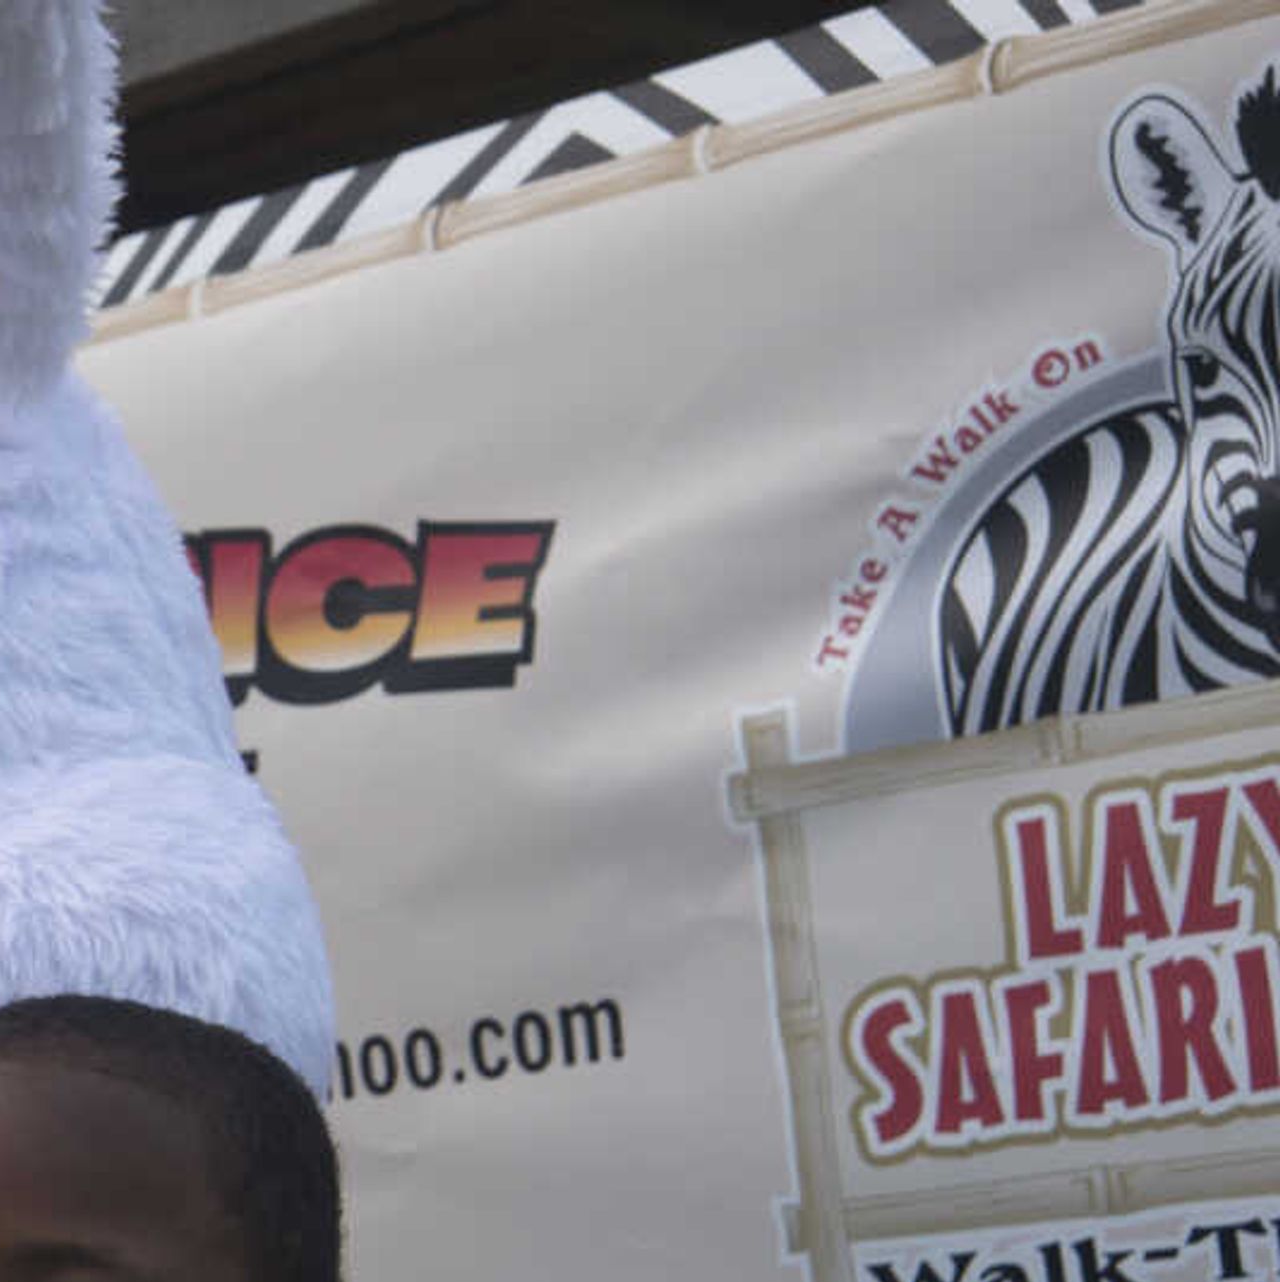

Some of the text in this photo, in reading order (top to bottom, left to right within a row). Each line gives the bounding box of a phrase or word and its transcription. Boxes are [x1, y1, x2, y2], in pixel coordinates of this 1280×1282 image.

[816, 338, 1105, 667] Take A Walk On
[859, 945, 1280, 1145] SAFARI
